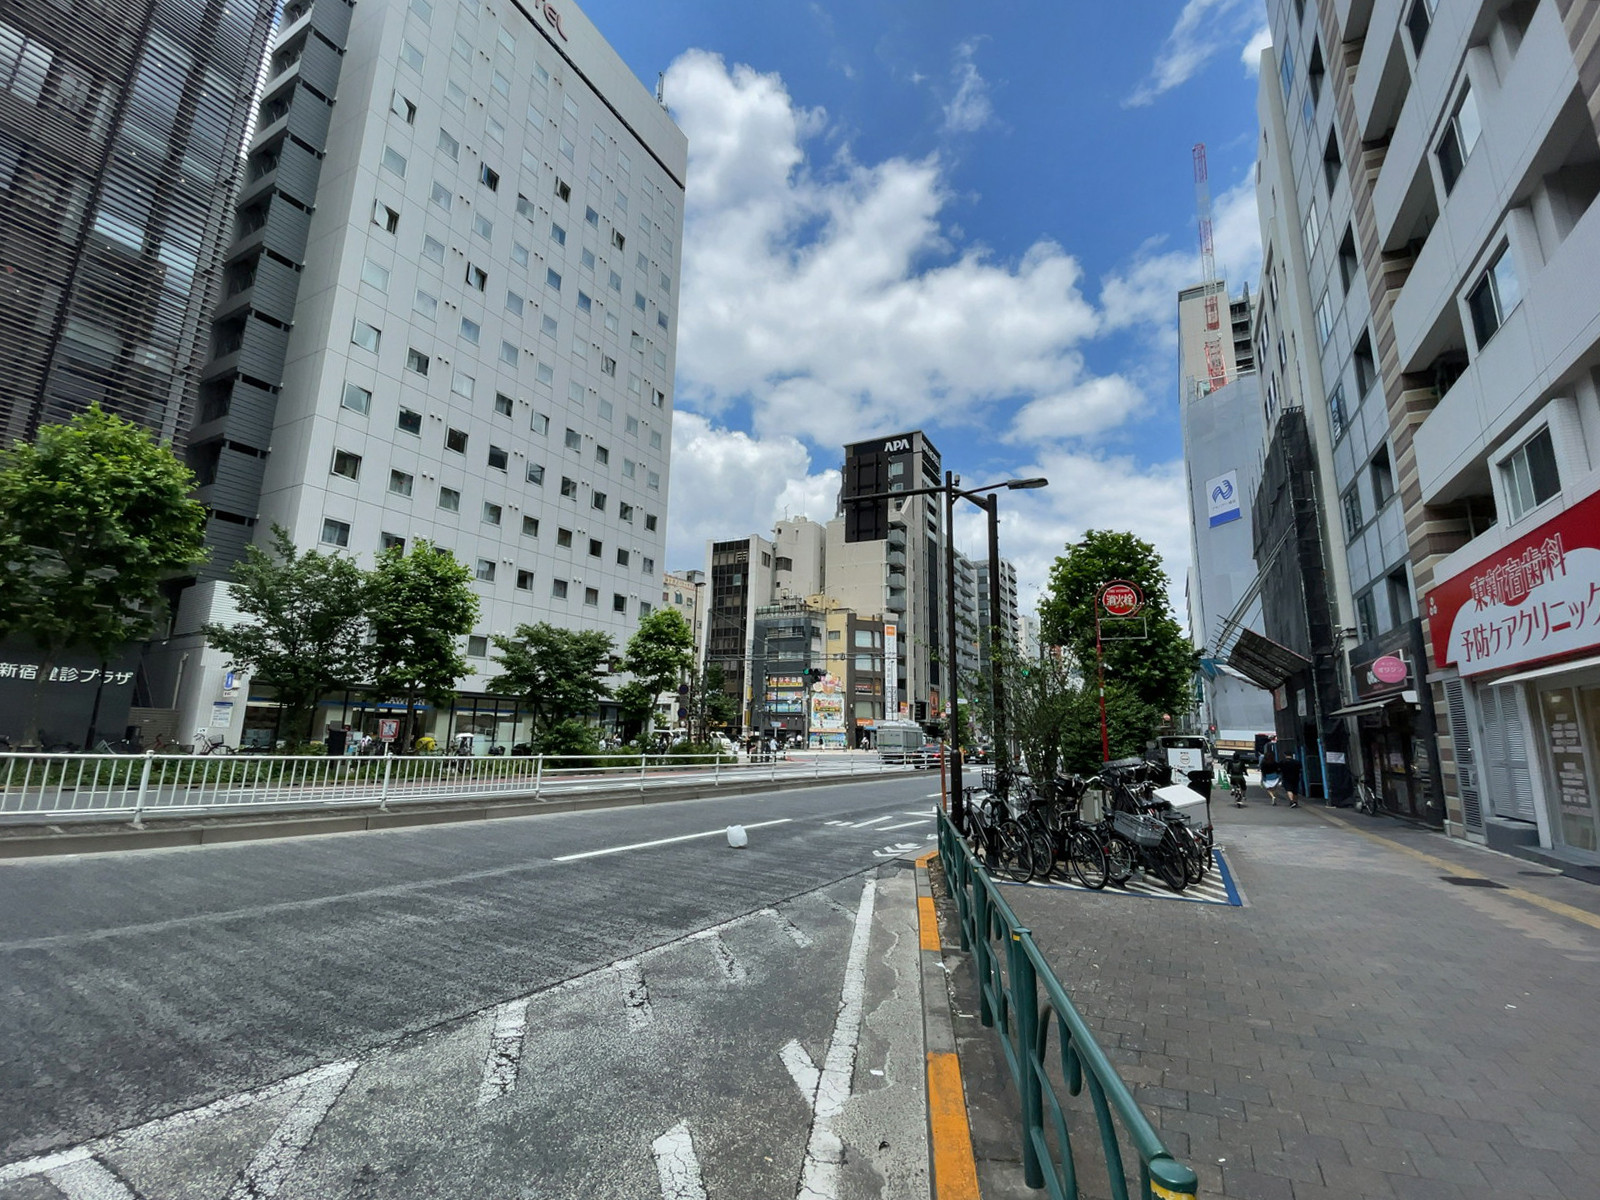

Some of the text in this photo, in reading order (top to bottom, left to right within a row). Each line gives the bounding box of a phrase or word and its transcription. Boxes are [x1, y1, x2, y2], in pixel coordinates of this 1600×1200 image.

[884, 438, 910, 452] APA
[1470, 532, 1567, 613] 東新宿歯科
[1106, 594, 1133, 608] 消火栓
